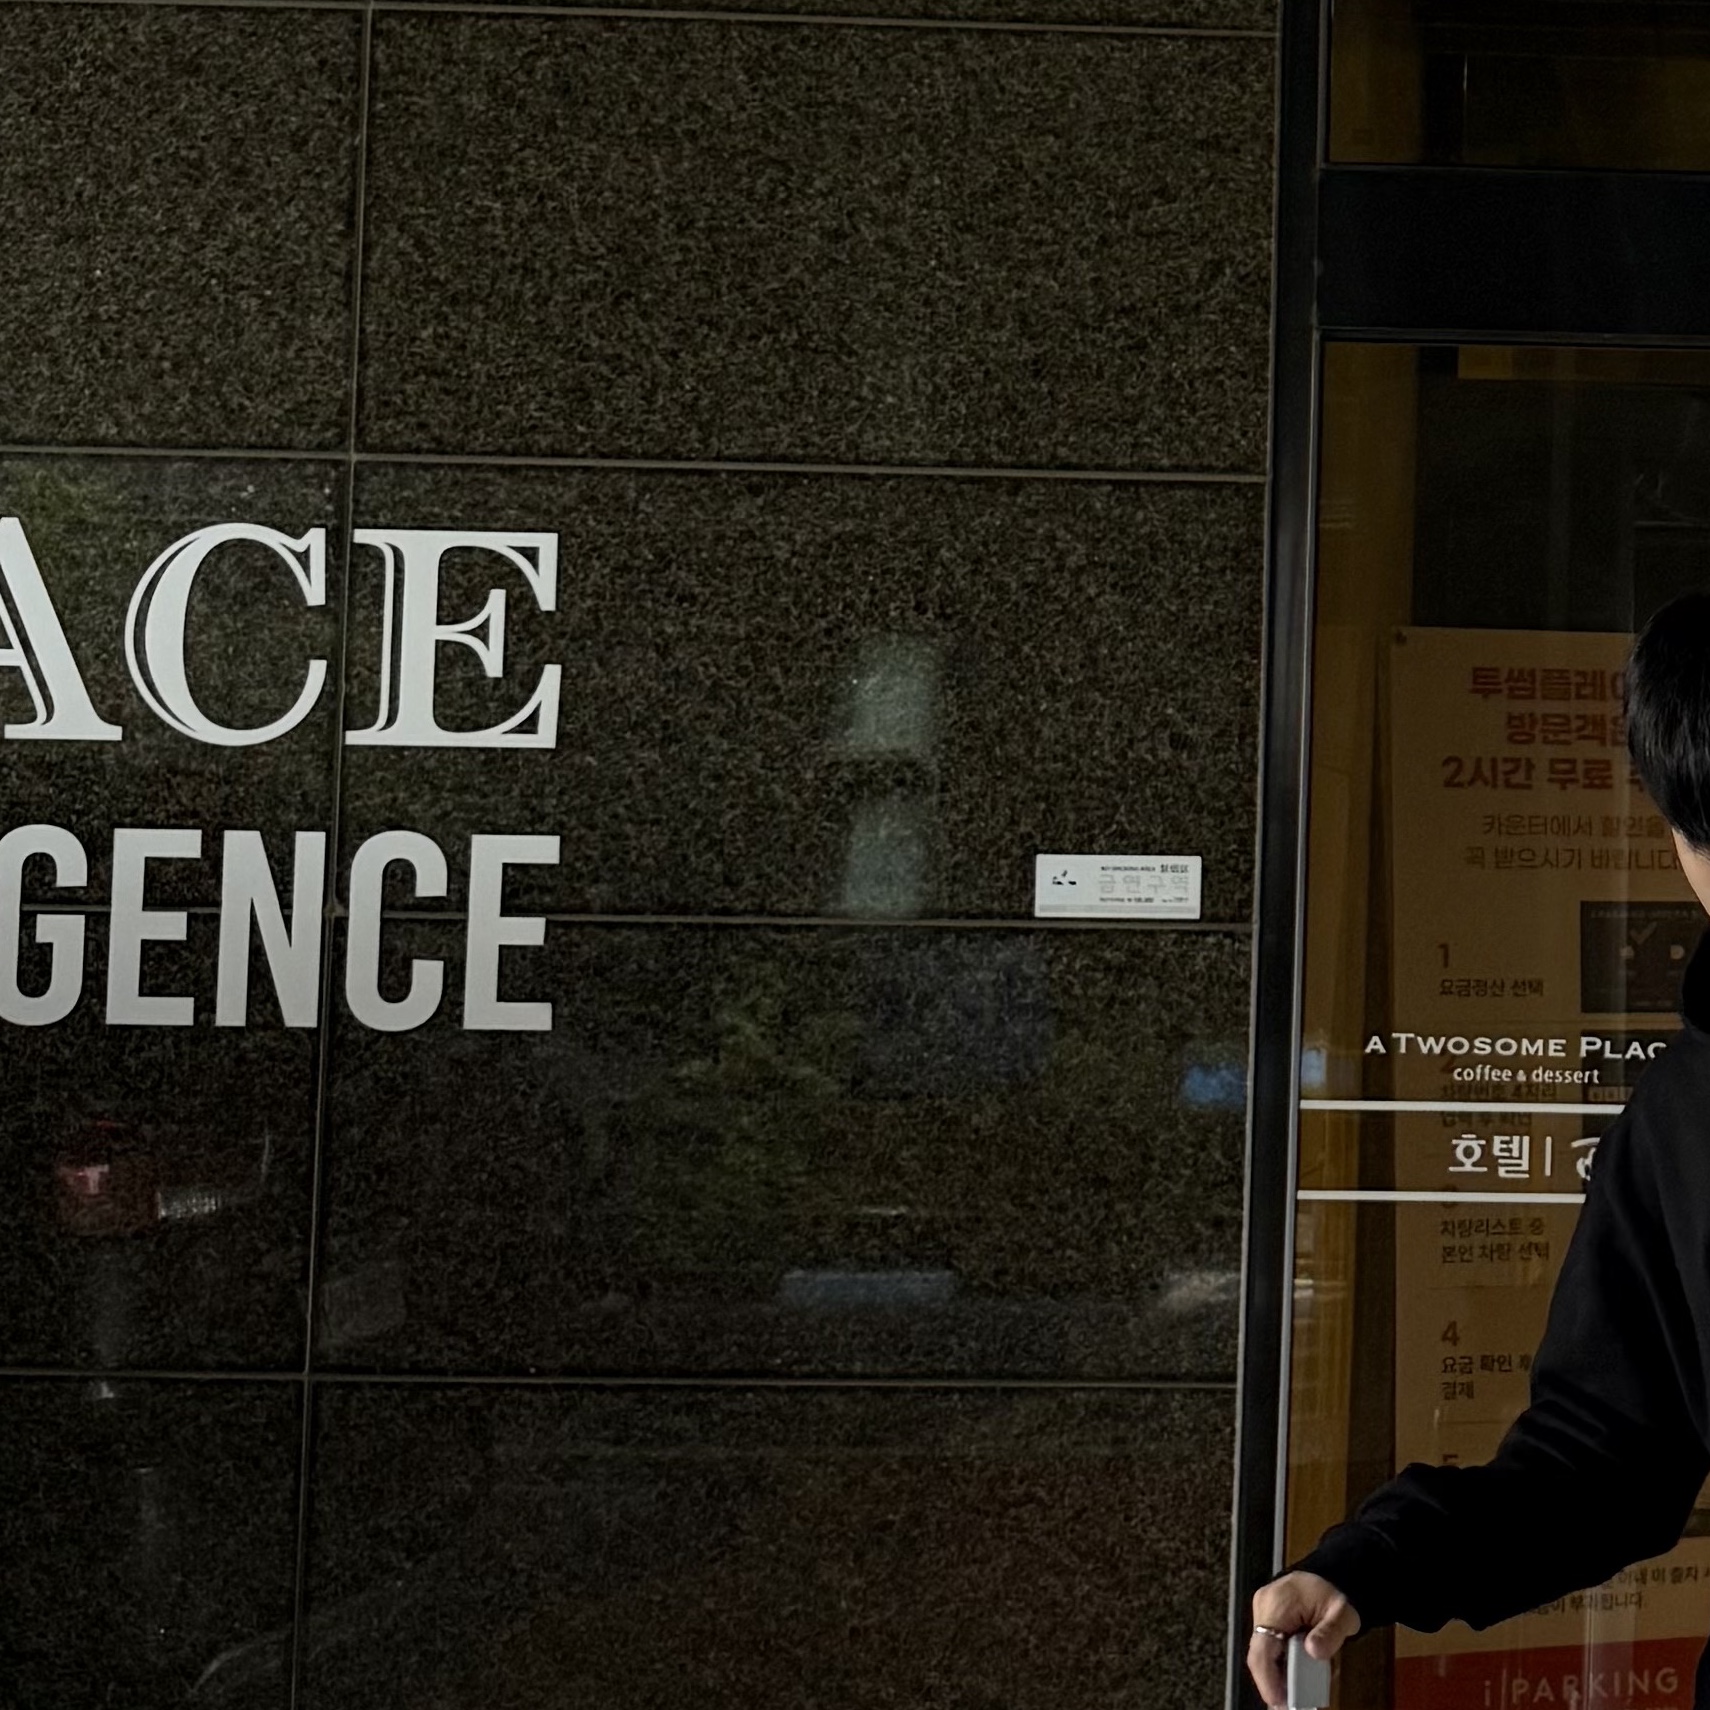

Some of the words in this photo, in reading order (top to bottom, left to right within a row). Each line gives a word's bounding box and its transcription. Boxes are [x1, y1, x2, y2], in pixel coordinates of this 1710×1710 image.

[1442, 756, 1535, 790] 2시간
[1547, 758, 1614, 790] 무료
[1483, 813, 1593, 838] 카운터에서
[0, 824, 561, 1032] GENCE
[1438, 943, 1450, 968] 1
[1364, 1035, 1387, 1054] A
[1391, 1032, 1567, 1058] TWOSOME
[1452, 1063, 1513, 1082] coffee
[1531, 1064, 1600, 1085] dessert
[1448, 1133, 1531, 1179] 호텔
[1441, 1320, 1460, 1346] 4
